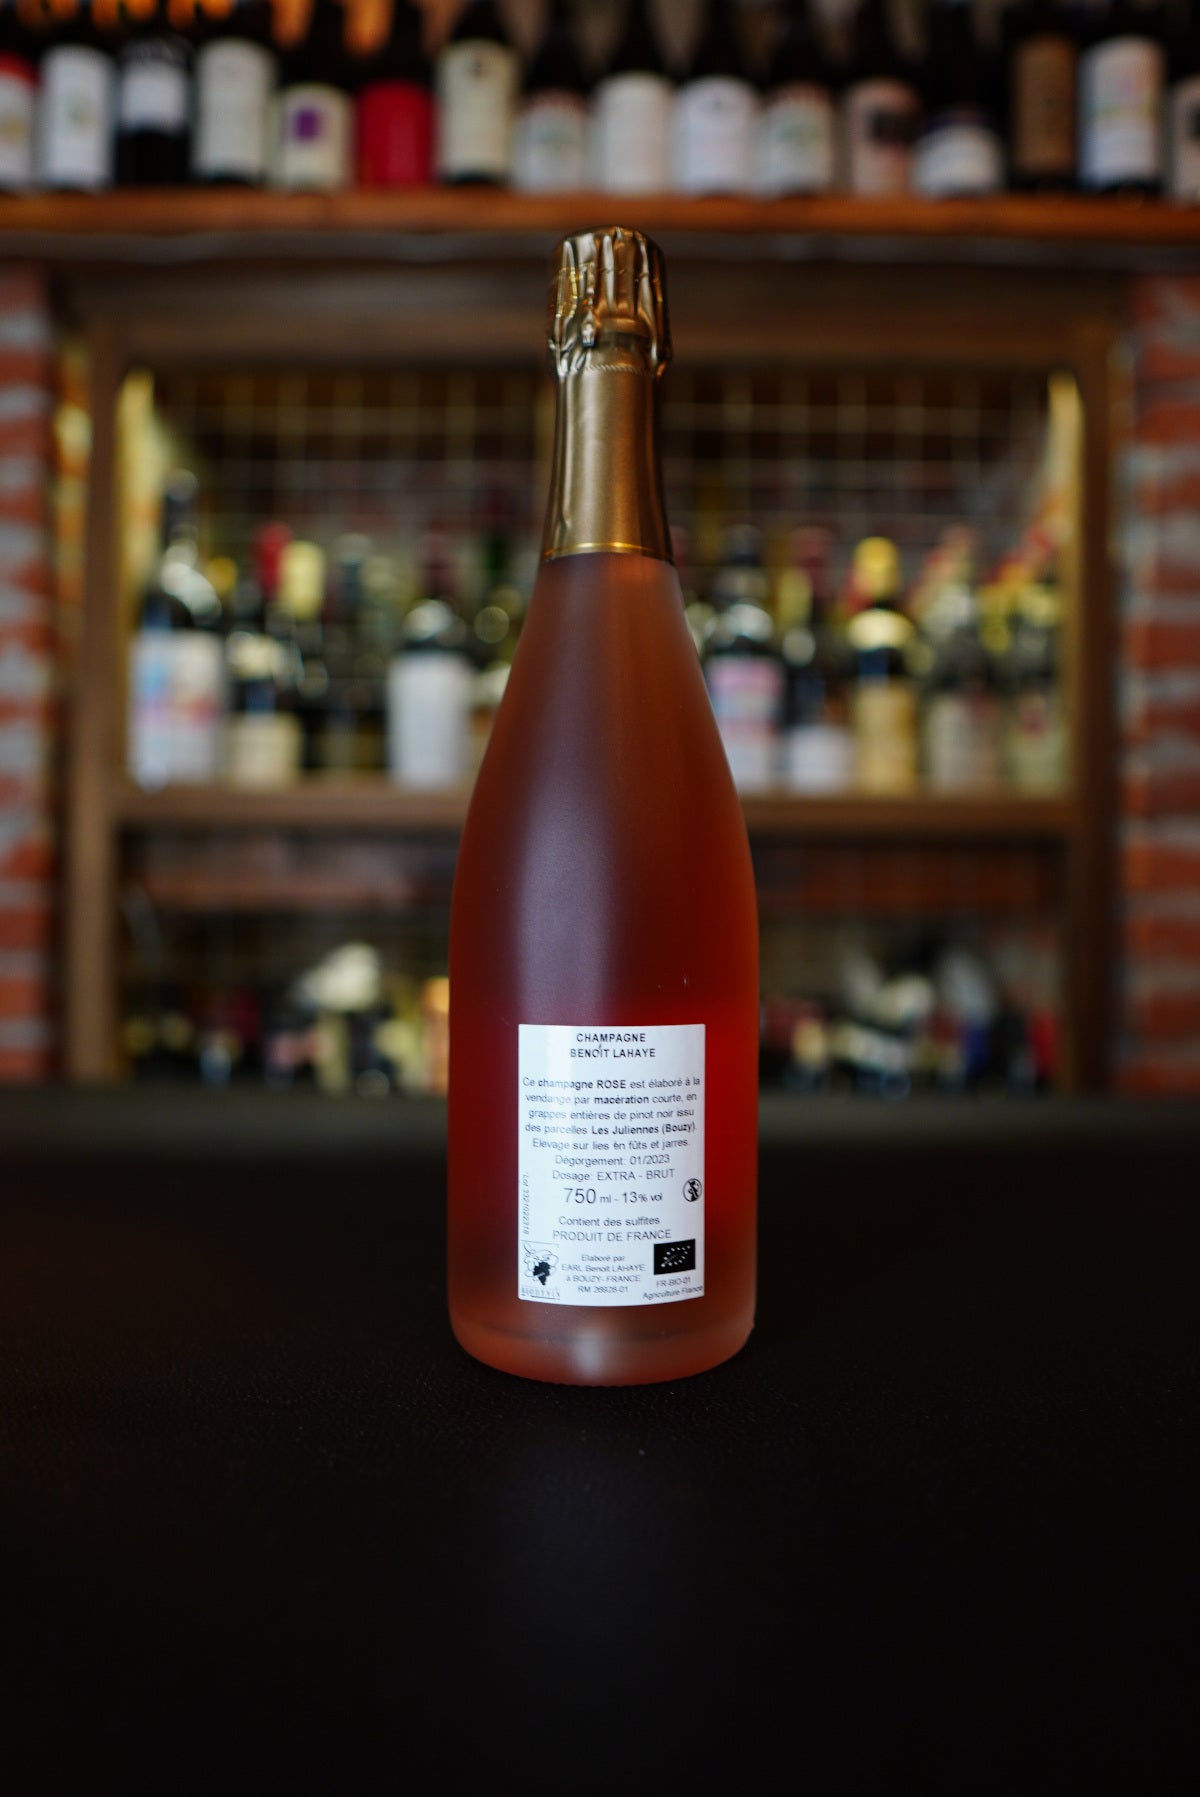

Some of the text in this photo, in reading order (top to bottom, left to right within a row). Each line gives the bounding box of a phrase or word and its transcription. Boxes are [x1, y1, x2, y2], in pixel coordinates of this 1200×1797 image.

[576, 1033, 646, 1043] CHAMPAGNE
[613, 1048, 656, 1057] LAHAYE
[522, 1077, 535, 1086] Ce
[538, 1078, 593, 1090] champagne
[597, 1080, 626, 1089] ROSE
[649, 1078, 682, 1088] élaboré
[685, 1078, 690, 1086] à
[693, 1077, 700, 1085] la
[525, 1093, 697, 1106] vendange par macération courte, en
[529, 1109, 694, 1122] grappes entières de pinot noir issu
[525, 1123, 541, 1132] des
[544, 1125, 587, 1136] parcelles
[592, 1126, 608, 1135] Les
[613, 1125, 659, 1135] Juliennes
[573, 1141, 588, 1149] sur
[592, 1141, 609, 1150] lies
[629, 1140, 647, 1149] fûts
[650, 1140, 659, 1148] et
[630, 1155, 670, 1165] 01/2023
[597, 1171, 636, 1181] EXTRA
[646, 1169, 675, 1179] BRUT
[563, 1188, 596, 1204] 750
[600, 1194, 611, 1203] ml
[650, 1193, 663, 1201] vol
[558, 1216, 660, 1226] Contient des sulfites
[553, 1229, 672, 1241] PRODUIT DE FRANCE
[613, 1255, 625, 1263] par
[606, 1274, 640, 1282] FRANCE
[642, 1290, 681, 1300] Agriculture
